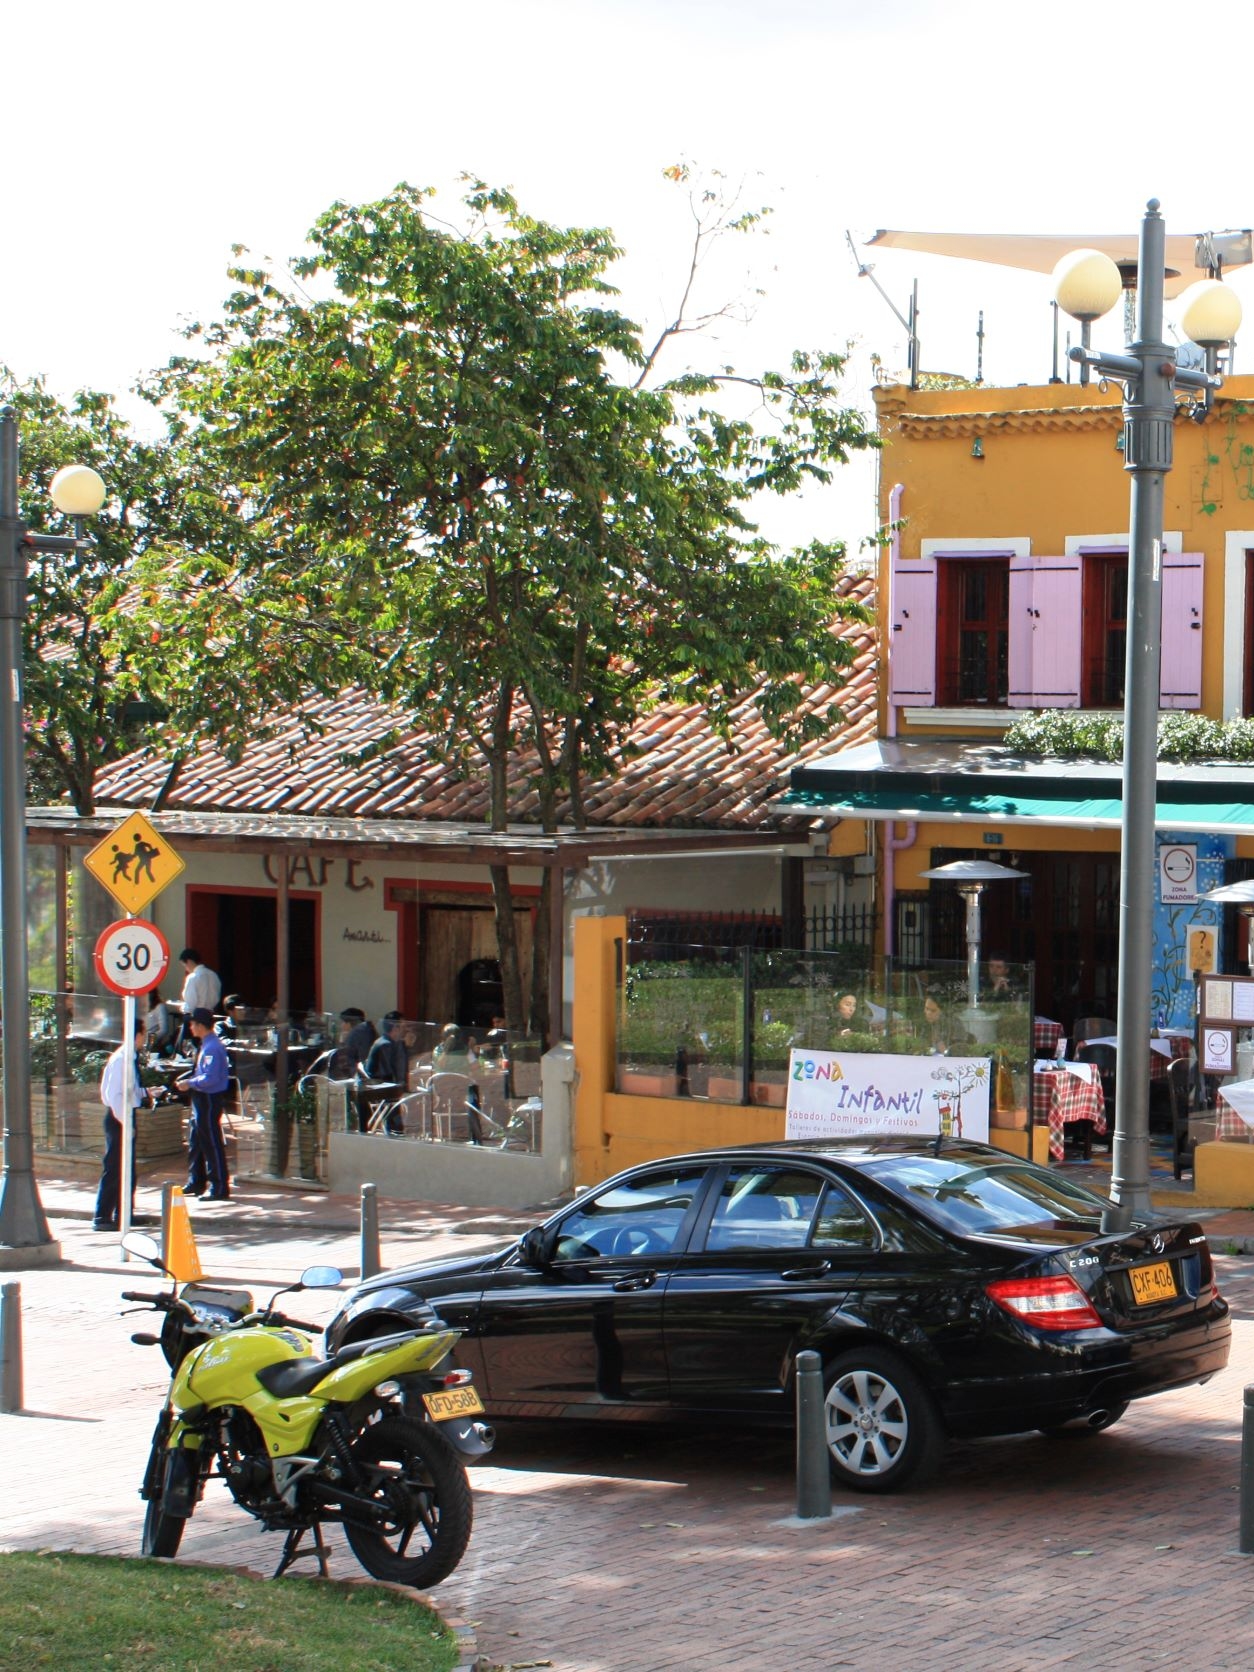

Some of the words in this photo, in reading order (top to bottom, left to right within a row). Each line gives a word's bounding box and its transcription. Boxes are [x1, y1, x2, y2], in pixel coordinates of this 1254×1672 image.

[115, 942, 151, 971] 30
[830, 1112, 873, 1125] Domingos
[882, 1115, 919, 1127] Festivos
